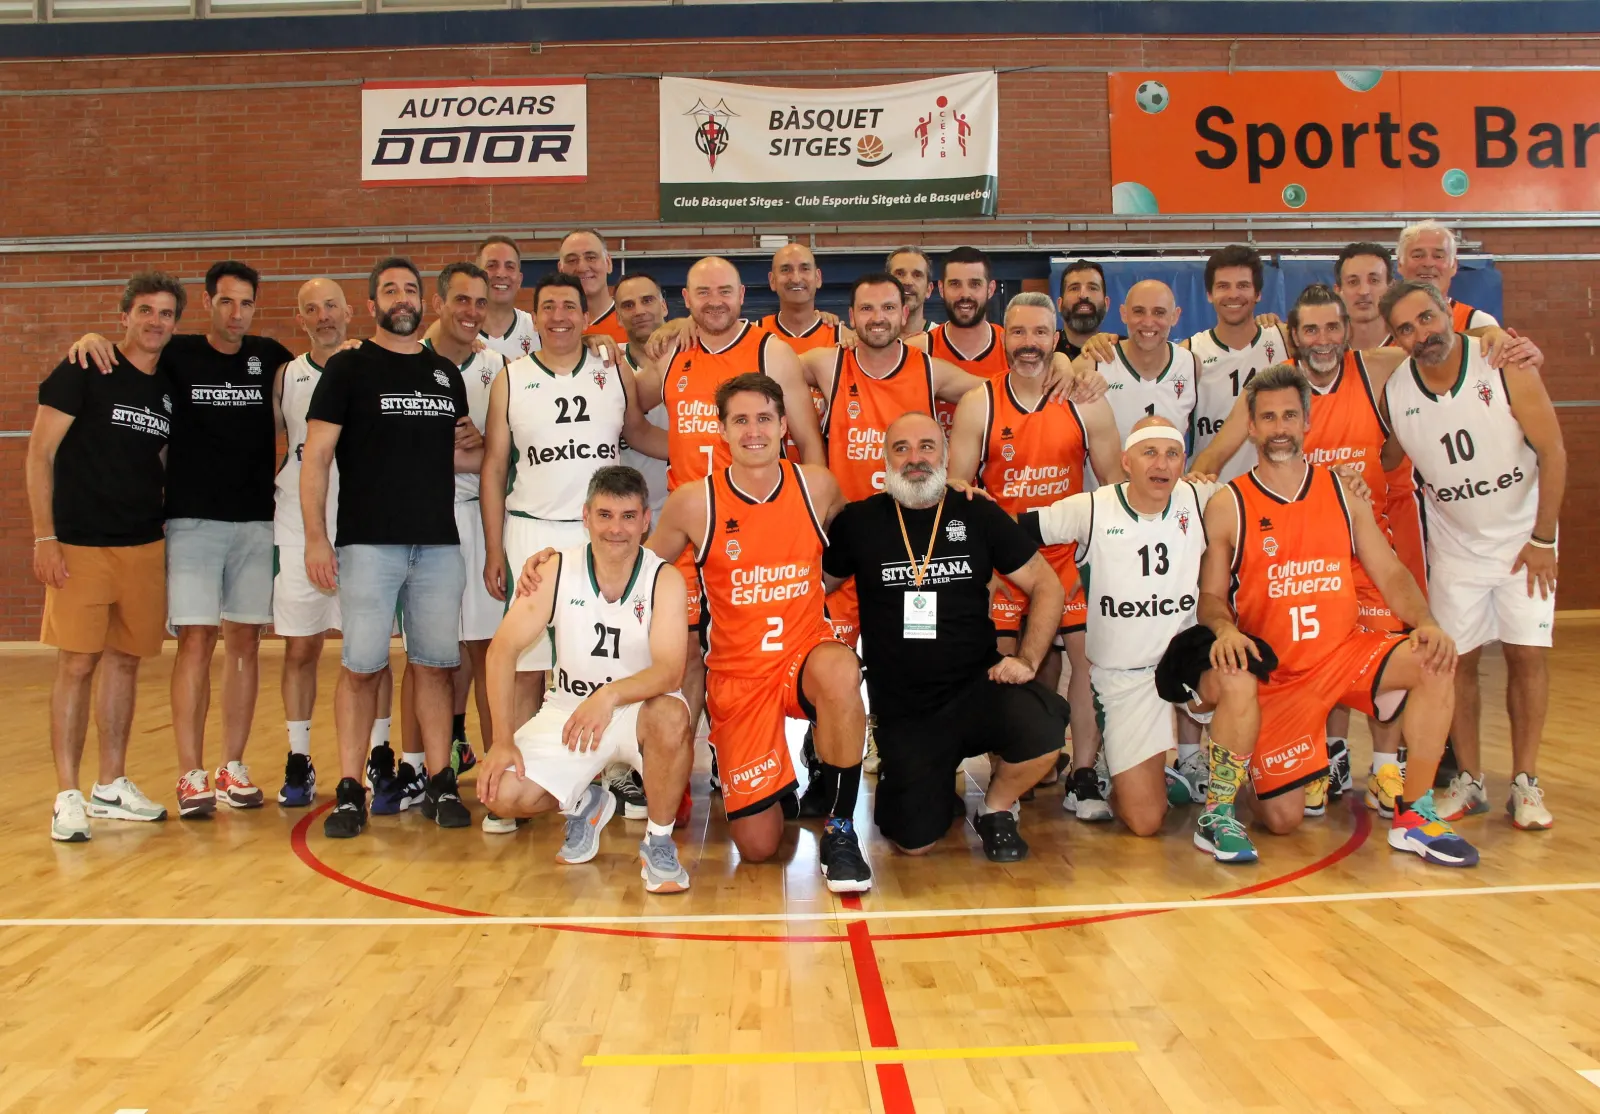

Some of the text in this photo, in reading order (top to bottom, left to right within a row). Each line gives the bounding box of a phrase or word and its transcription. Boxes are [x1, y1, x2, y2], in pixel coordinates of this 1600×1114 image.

[398, 95, 556, 119] AUTOCARS
[768, 105, 884, 132] BÀSQUET
[371, 124, 576, 166] DOTOR
[768, 136, 852, 157] SITGES
[1194, 105, 1600, 184] Sports Bar
[673, 196, 699, 207] Club
[701, 196, 747, 209] Bàsquet
[749, 196, 784, 209] Sitges
[794, 195, 820, 207] Club
[822, 194, 870, 208] Esportiu
[871, 193, 911, 207] Sitgetà
[913, 192, 928, 204] de
[929, 189, 991, 204] Basquetbol
[191, 389, 263, 400] SITGETANA
[380, 398, 456, 413] SITGETANA
[555, 395, 591, 424] 22
[677, 400, 719, 416] Cultur
[112, 408, 170, 435] SITGETANA
[677, 415, 720, 433] Esfue
[847, 427, 885, 443] Cultu
[1440, 428, 1476, 465] 10
[527, 438, 616, 467] flexic.es
[1303, 447, 1351, 464] ultura
[1003, 465, 1058, 482] Cultura
[1002, 478, 1071, 498] Esfuerzo
[1137, 542, 1170, 577] 13
[1267, 558, 1341, 581] Cultura del
[730, 564, 797, 587] Cultura
[907, 578, 931, 587] CRFT
[1268, 576, 1342, 598] Esfuerzo
[731, 580, 809, 606] Esfuerzo
[1099, 593, 1196, 619] flexic.e
[761, 616, 784, 652] 2
[1288, 604, 1320, 642] 15
[590, 622, 621, 659] 27
[1265, 742, 1310, 768] PULEVA
[733, 758, 776, 785] PULEVA
